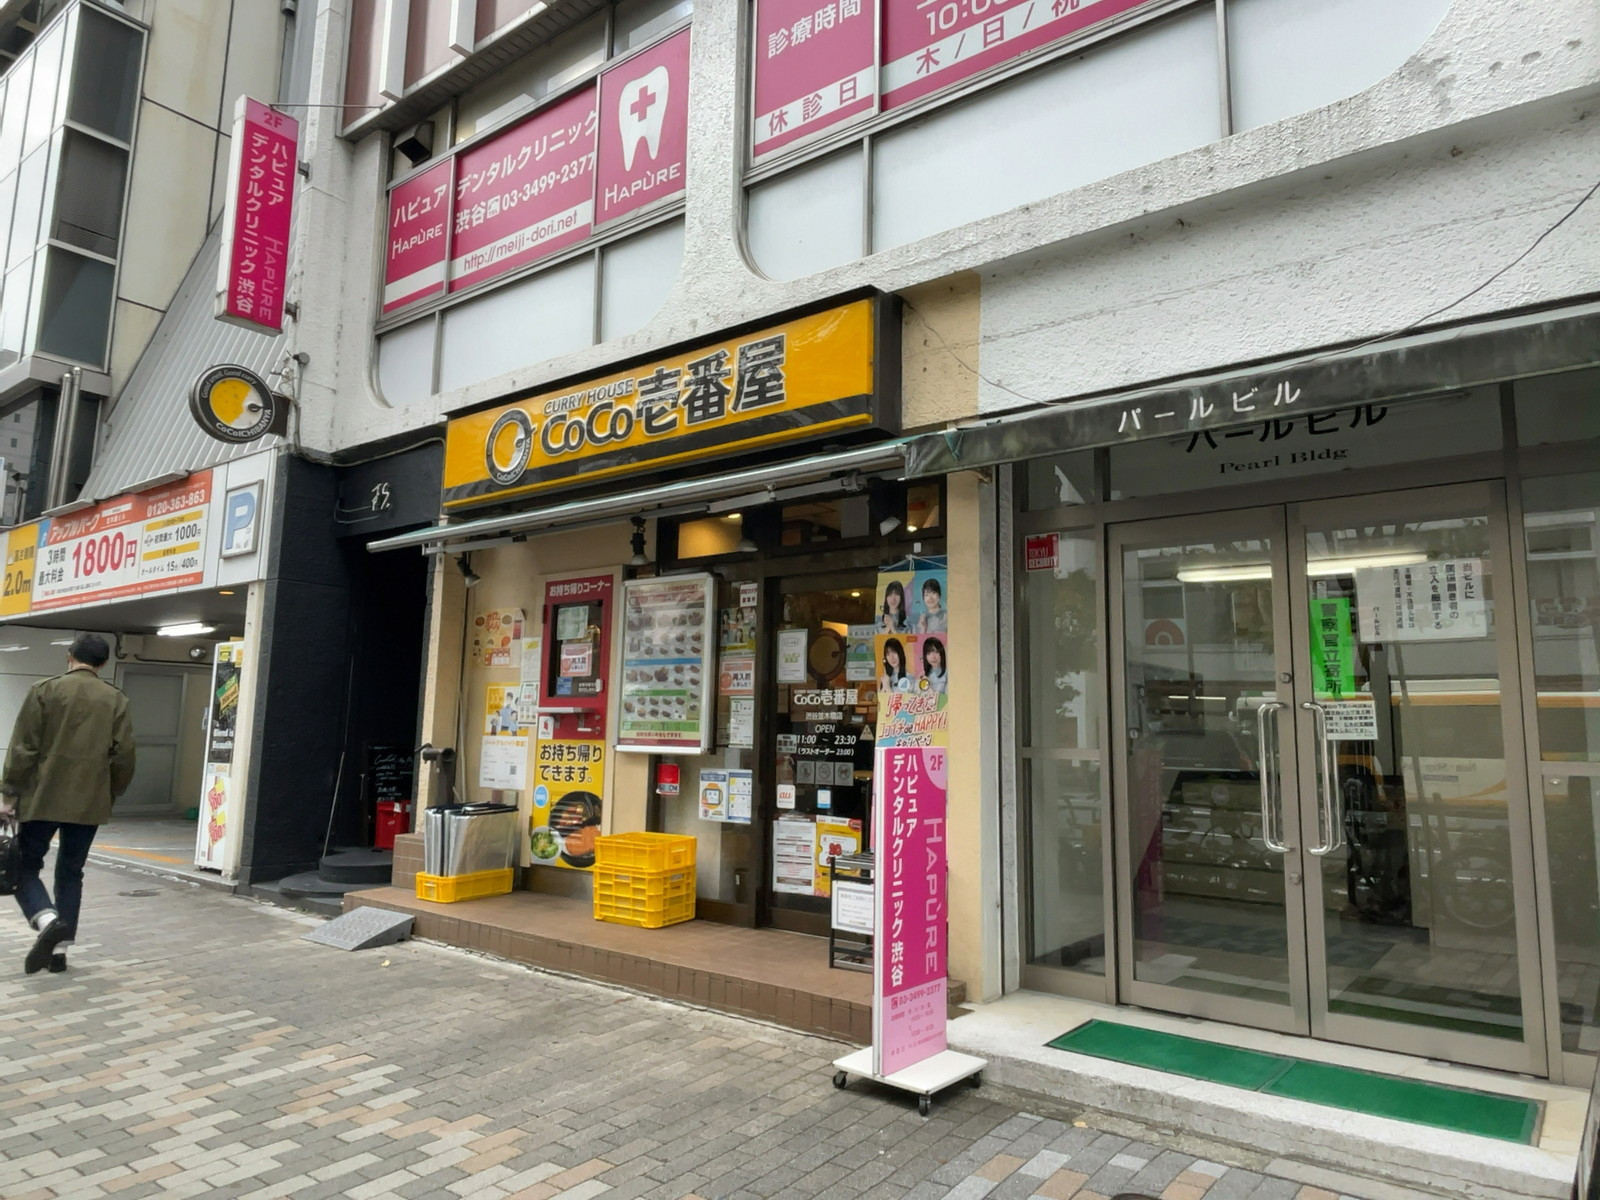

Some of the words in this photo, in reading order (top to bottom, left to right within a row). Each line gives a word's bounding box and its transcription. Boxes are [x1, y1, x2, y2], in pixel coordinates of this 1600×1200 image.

[768, 0, 861, 59] 診療時間
[264, 112, 283, 128] 2F
[768, 77, 858, 136] 休診日
[457, 110, 599, 201] デンタルクリニック
[502, 151, 597, 212] 03-3499-2377
[236, 132, 269, 314] デンタルクリニック渋谷
[455, 201, 486, 236] 渋谷
[463, 210, 579, 272] http://meiji-dori.net
[539, 333, 787, 457] CoCo壱番屋
[543, 391, 585, 416] CURRY
[587, 378, 634, 405] HOUSE
[1117, 380, 1301, 433] パールビル
[1219, 456, 1281, 475] Pearl
[1291, 448, 1349, 465] Bldg
[225, 491, 256, 550] P
[72, 531, 138, 579] 1800円
[550, 579, 612, 597] お持ち帰りコーナー
[793, 688, 859, 706] CoCo壱番屋
[815, 724, 836, 734] OPEN
[834, 735, 857, 745] 23:30
[538, 764, 593, 784] できます。
[540, 743, 603, 764] お持ち帰り
[930, 754, 944, 771] 2F
[778, 791, 792, 800] au
[906, 753, 919, 838] ハピュア
[891, 753, 906, 988] デンタルクリニック渋谷
